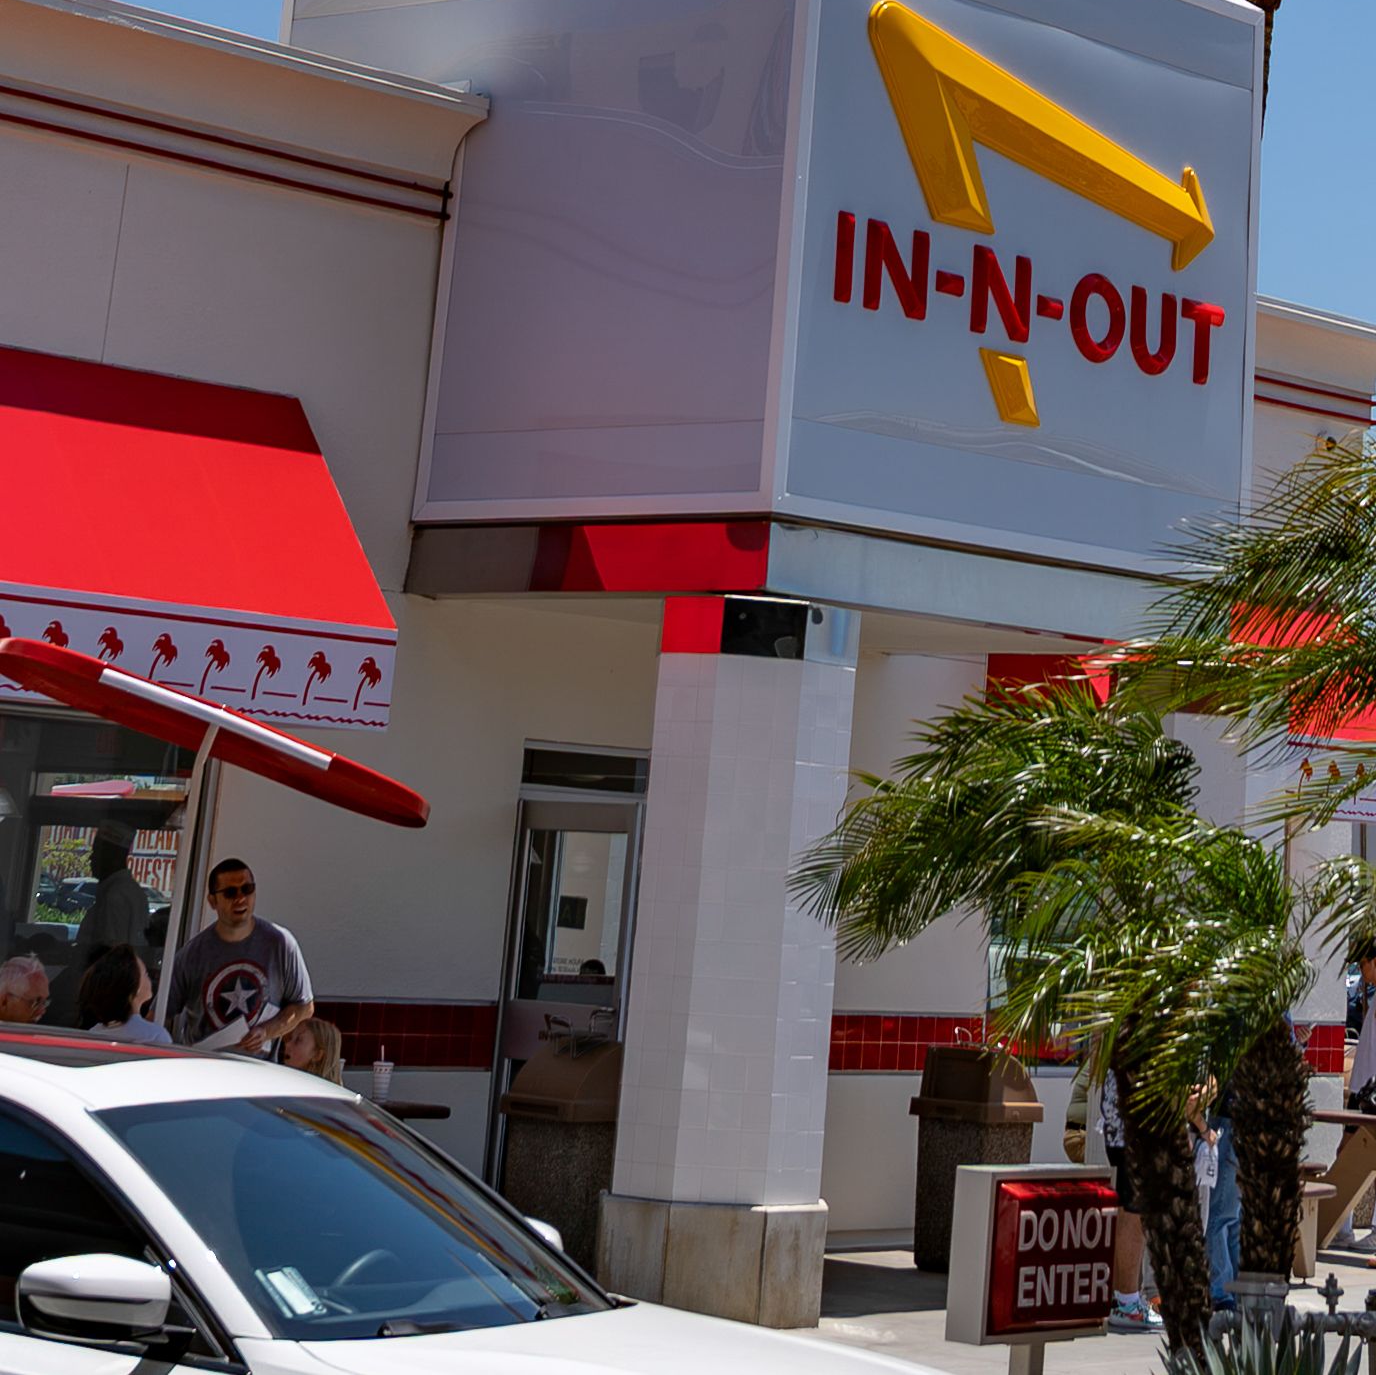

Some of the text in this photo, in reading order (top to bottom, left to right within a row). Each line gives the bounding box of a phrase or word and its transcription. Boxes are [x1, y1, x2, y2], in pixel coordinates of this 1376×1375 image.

[833, 209, 1226, 385] IN-N-OUT
[1018, 1207, 1118, 1252] DO NOT
[1017, 1262, 1110, 1308] ENTER
